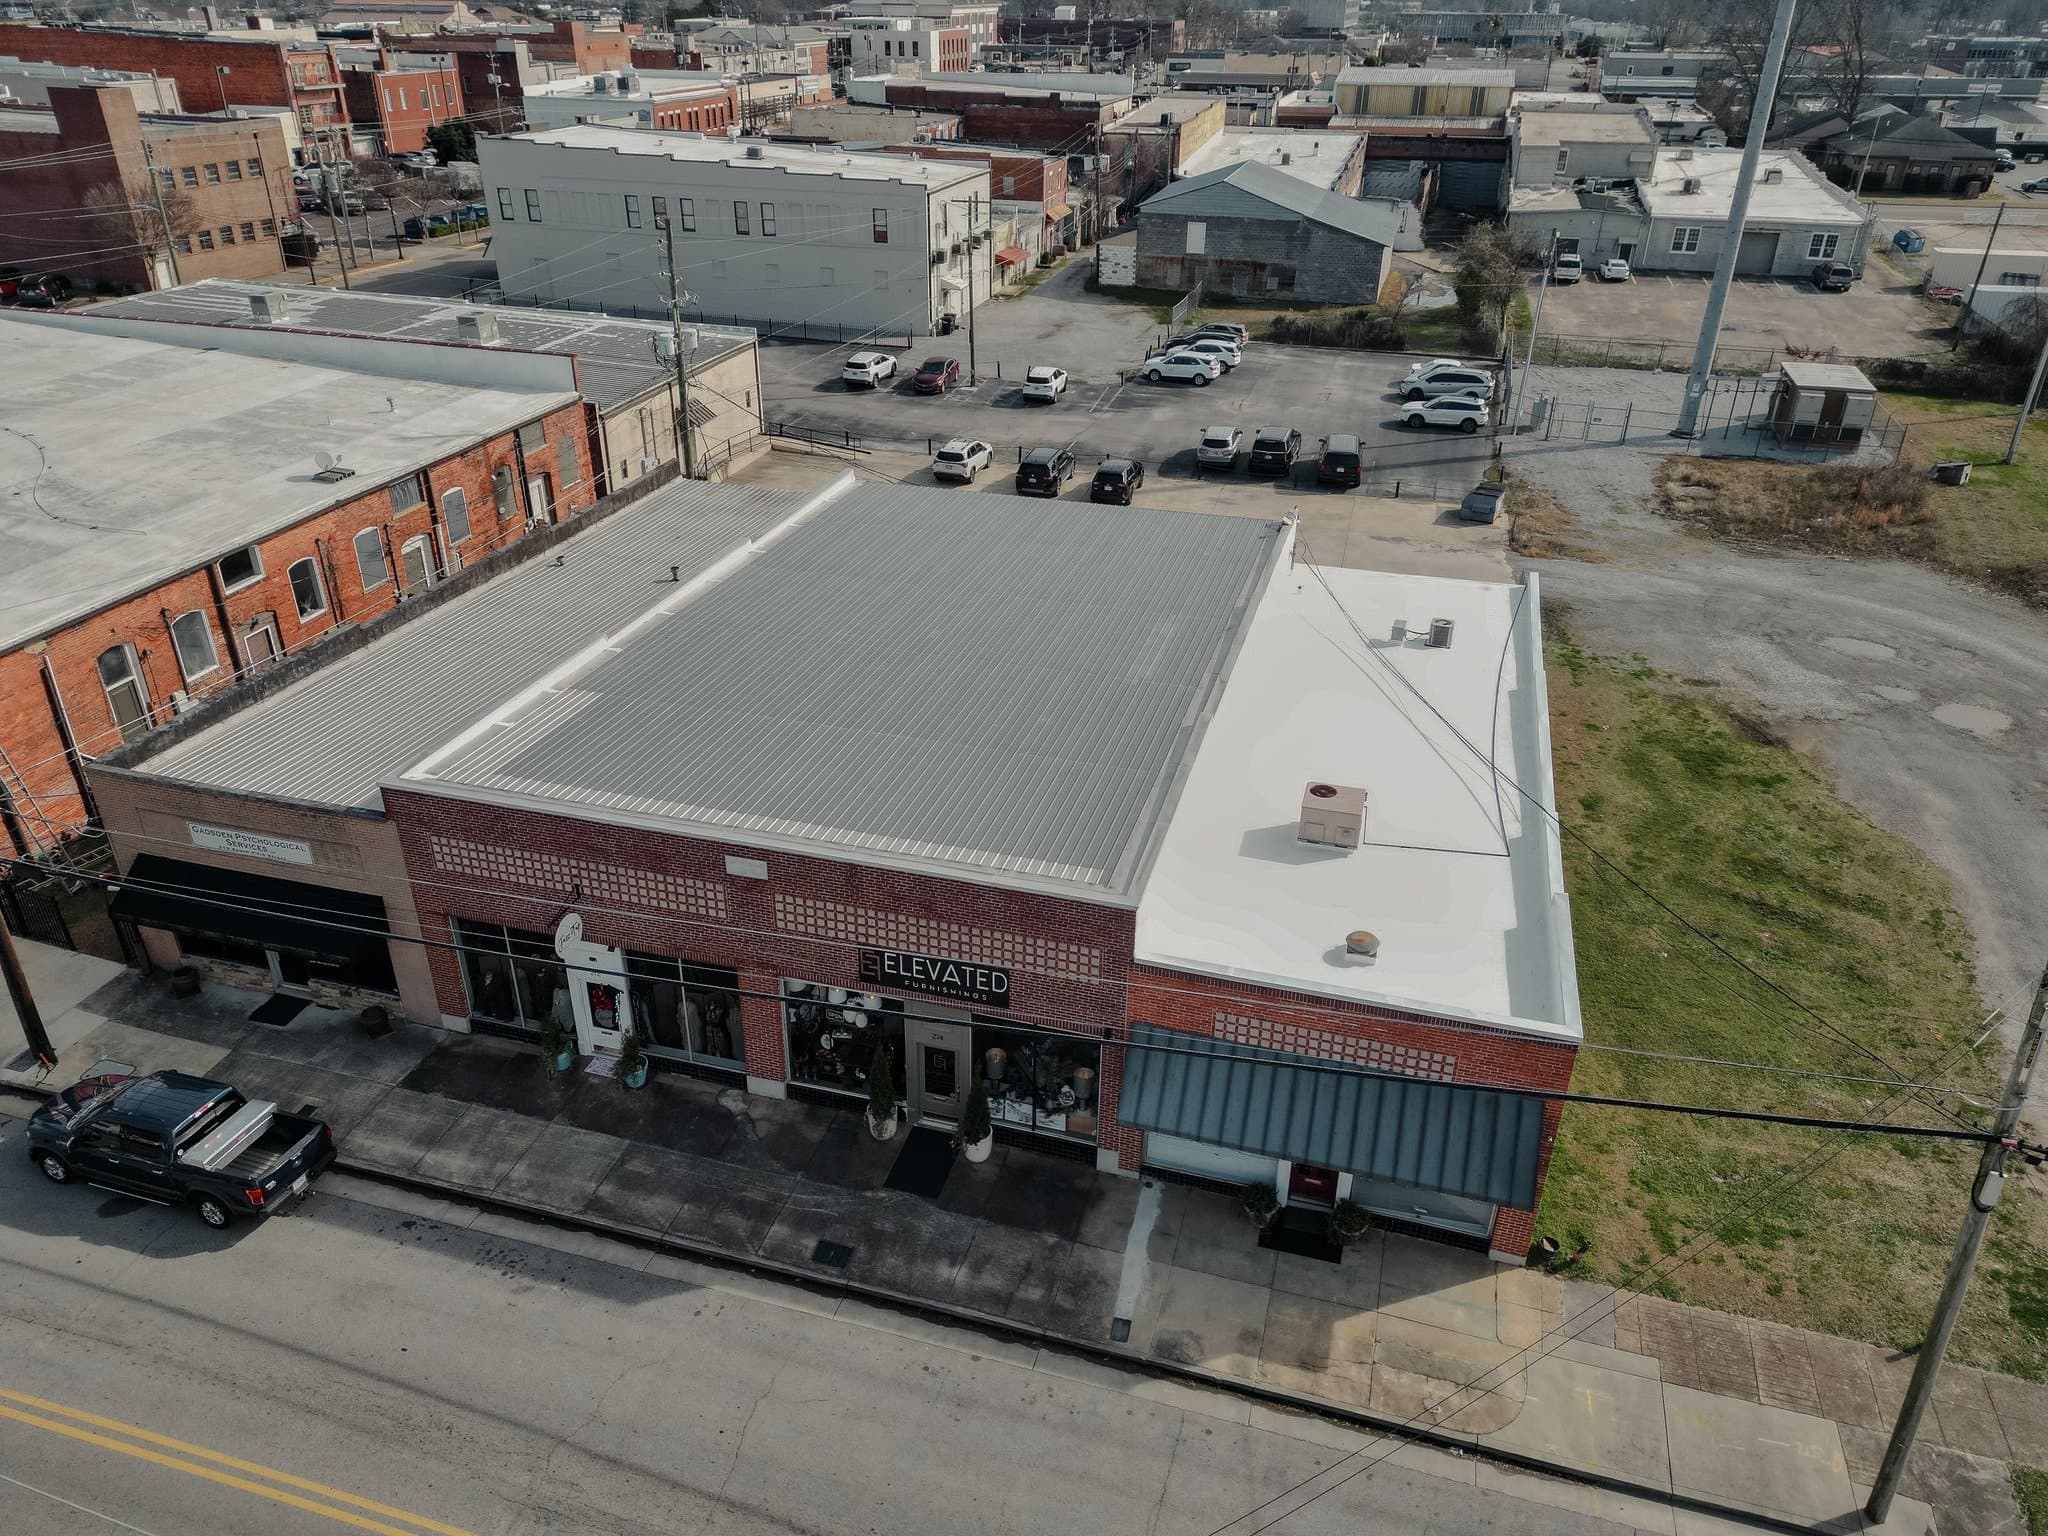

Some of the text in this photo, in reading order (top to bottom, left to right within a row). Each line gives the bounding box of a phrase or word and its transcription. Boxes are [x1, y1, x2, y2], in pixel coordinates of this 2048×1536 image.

[191, 825, 306, 851] GADSDEN PSYCHOLOGICAL
[226, 838, 268, 852] SERVICES
[884, 952, 1008, 993] ELEVATED
[904, 980, 987, 1001] FURNISHINGS
[931, 1032, 944, 1041] 214
